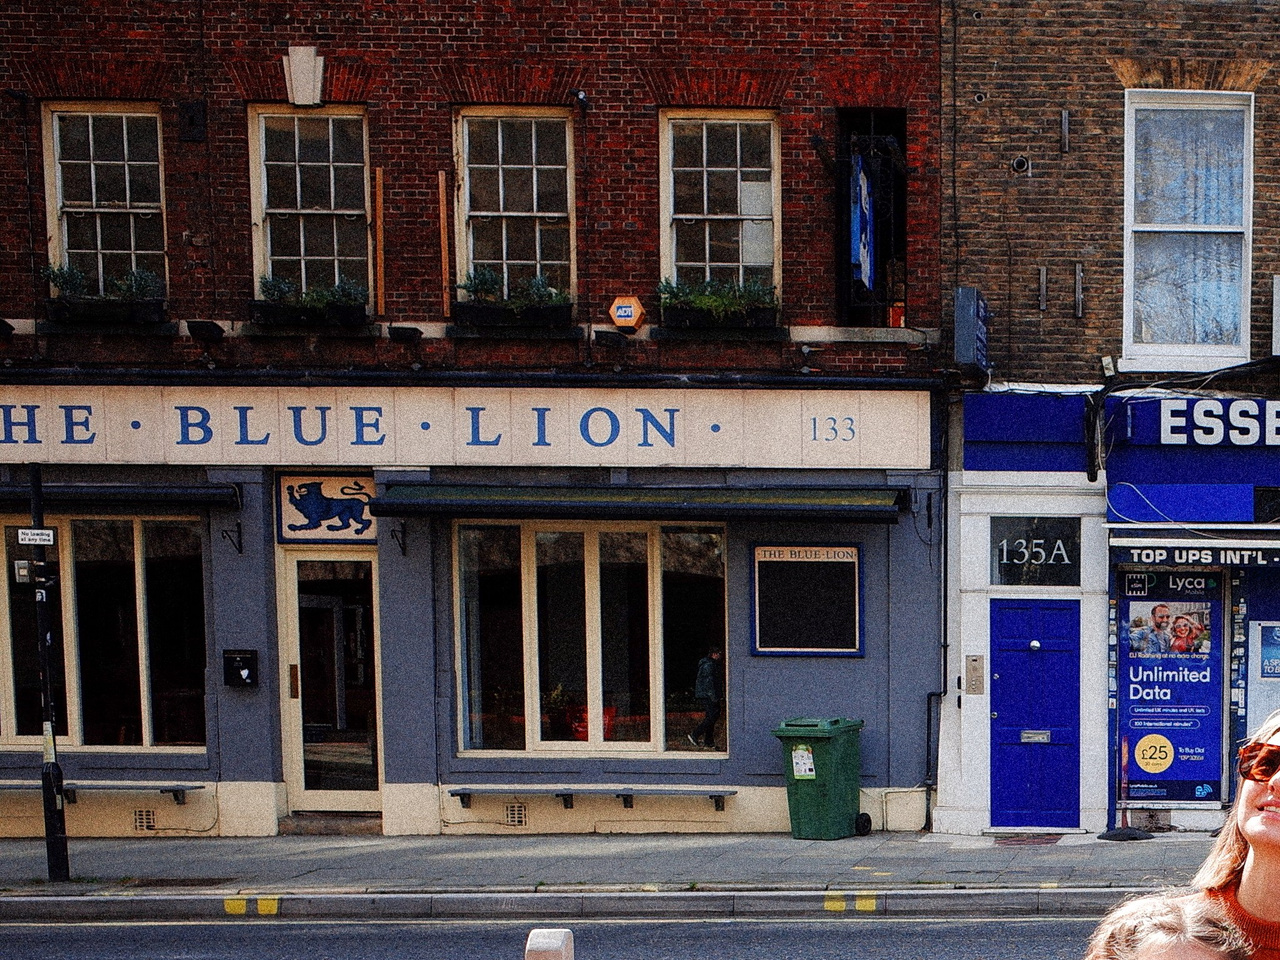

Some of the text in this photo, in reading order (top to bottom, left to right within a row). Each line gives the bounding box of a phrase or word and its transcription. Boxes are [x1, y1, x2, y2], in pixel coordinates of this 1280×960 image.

[617, 307, 632, 316] ADT
[174, 405, 387, 446] BLUE
[465, 407, 680, 448] LION
[809, 416, 857, 443] 133
[761, 549, 854, 560] THE BLUE LION
[998, 538, 1073, 567] 135A
[1130, 549, 1167, 563] TOP
[1174, 549, 1213, 564] UPS
[1220, 550, 1267, 565] INT'L
[1169, 575, 1206, 591] Lyca
[1263, 659, 1270, 667] A
[1264, 666, 1275, 674] TO
[1129, 666, 1211, 683] Unlimited
[1129, 684, 1172, 700] Data
[1141, 745, 1168, 760] £25
